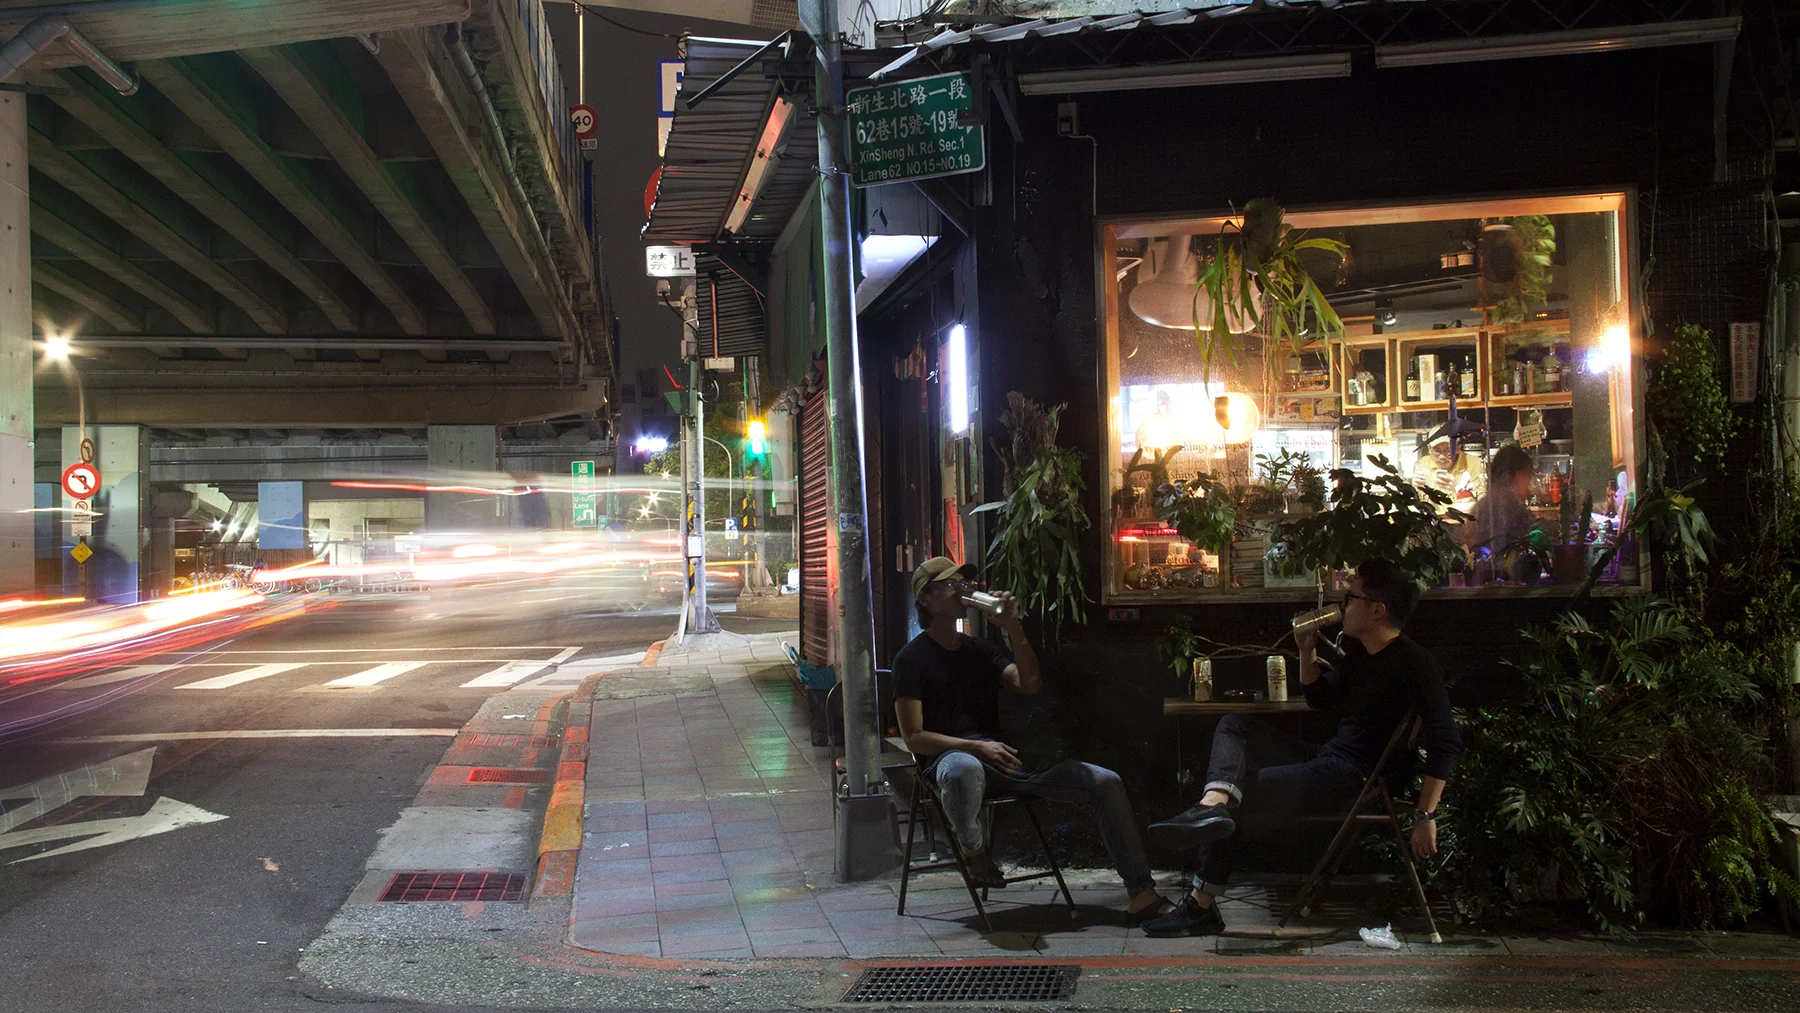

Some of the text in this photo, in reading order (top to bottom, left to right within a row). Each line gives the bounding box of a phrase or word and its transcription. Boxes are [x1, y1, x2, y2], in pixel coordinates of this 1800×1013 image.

[855, 78, 967, 115] 新生北路一段
[571, 115, 592, 131] 40
[859, 136, 965, 164] XinSheng N. Rd. Sec.1
[860, 168, 888, 182] Lane
[888, 163, 901, 178] 62
[650, 251, 697, 271] 禁止
[726, 519, 734, 530] P
